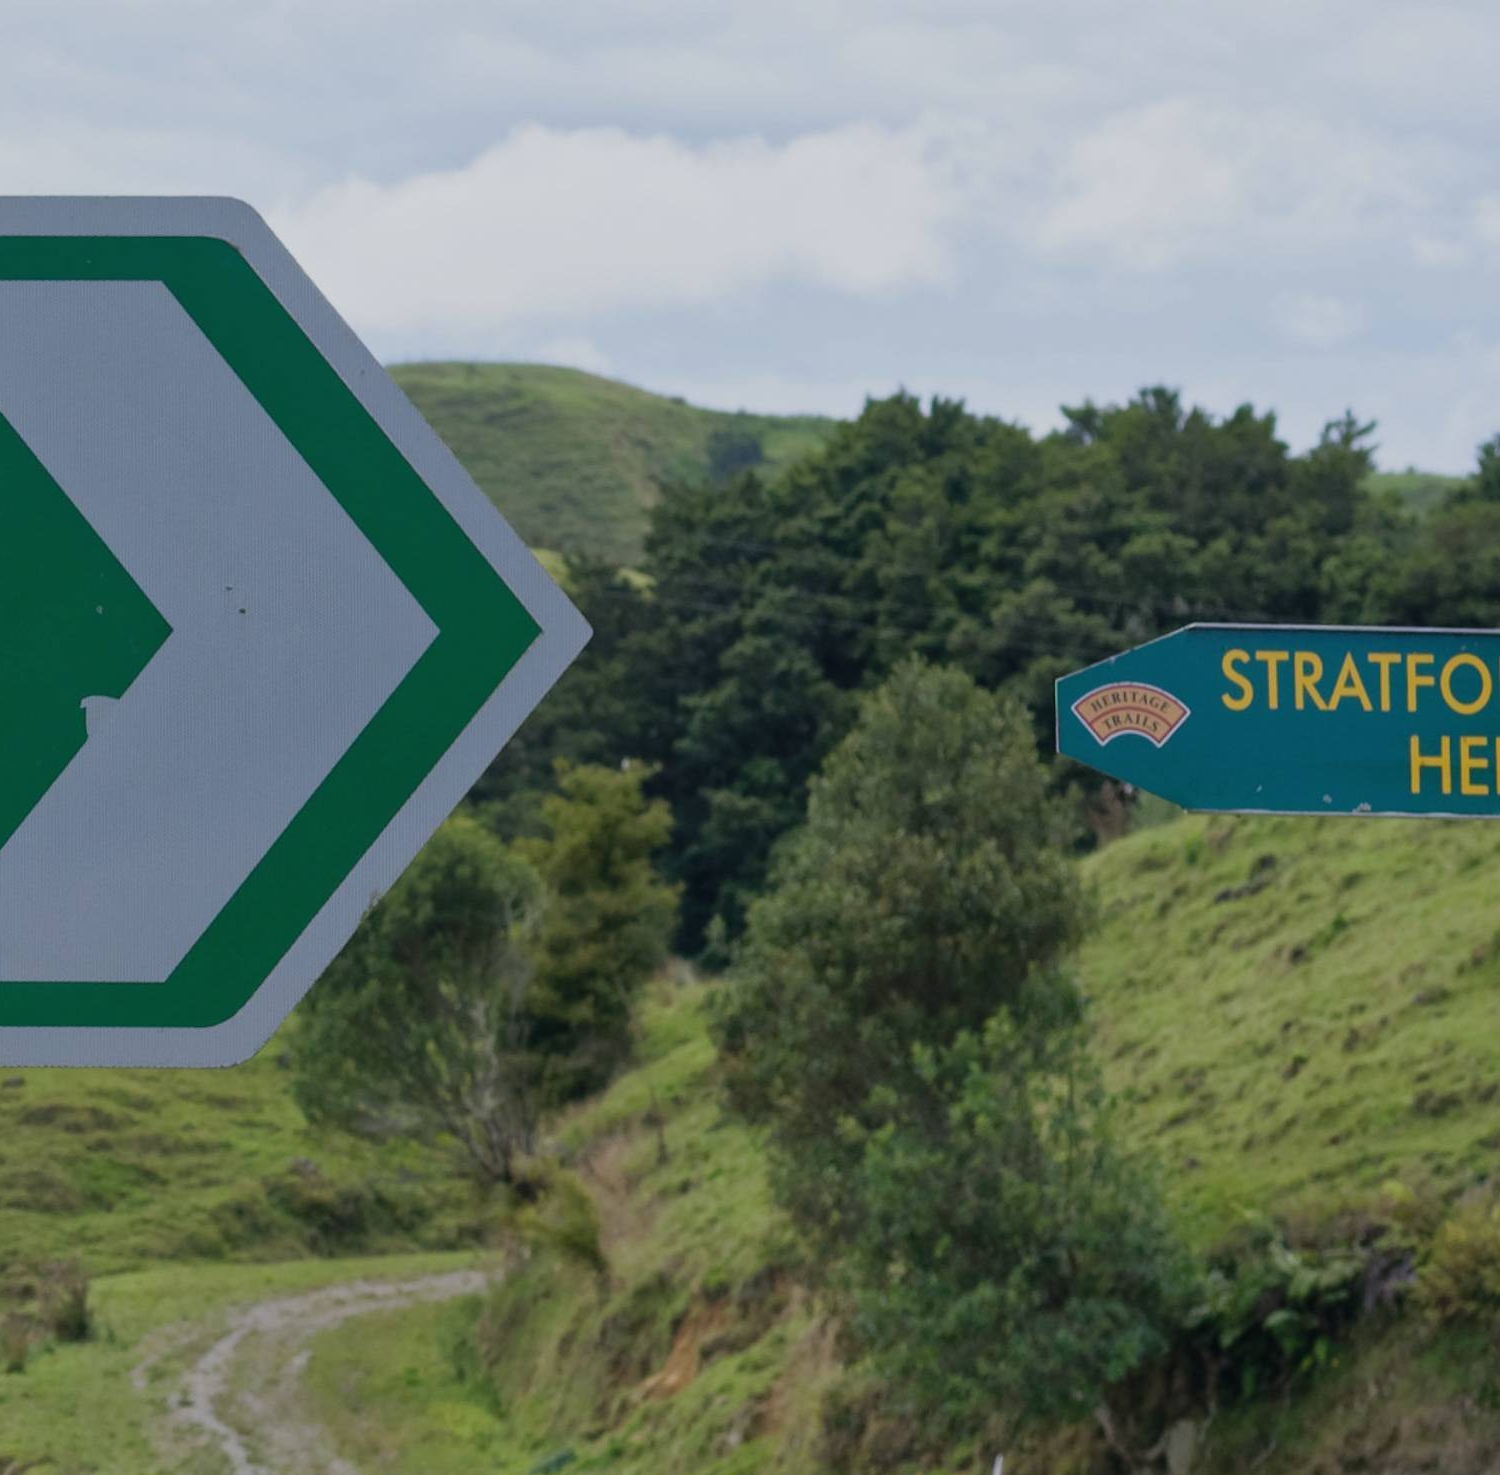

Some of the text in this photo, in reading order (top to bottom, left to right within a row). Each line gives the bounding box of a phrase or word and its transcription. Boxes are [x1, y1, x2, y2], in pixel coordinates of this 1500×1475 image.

[1220, 648, 1500, 716] STRATFO
[1090, 690, 1170, 715] HERITAGE
[1103, 712, 1160, 733] TRAILS
